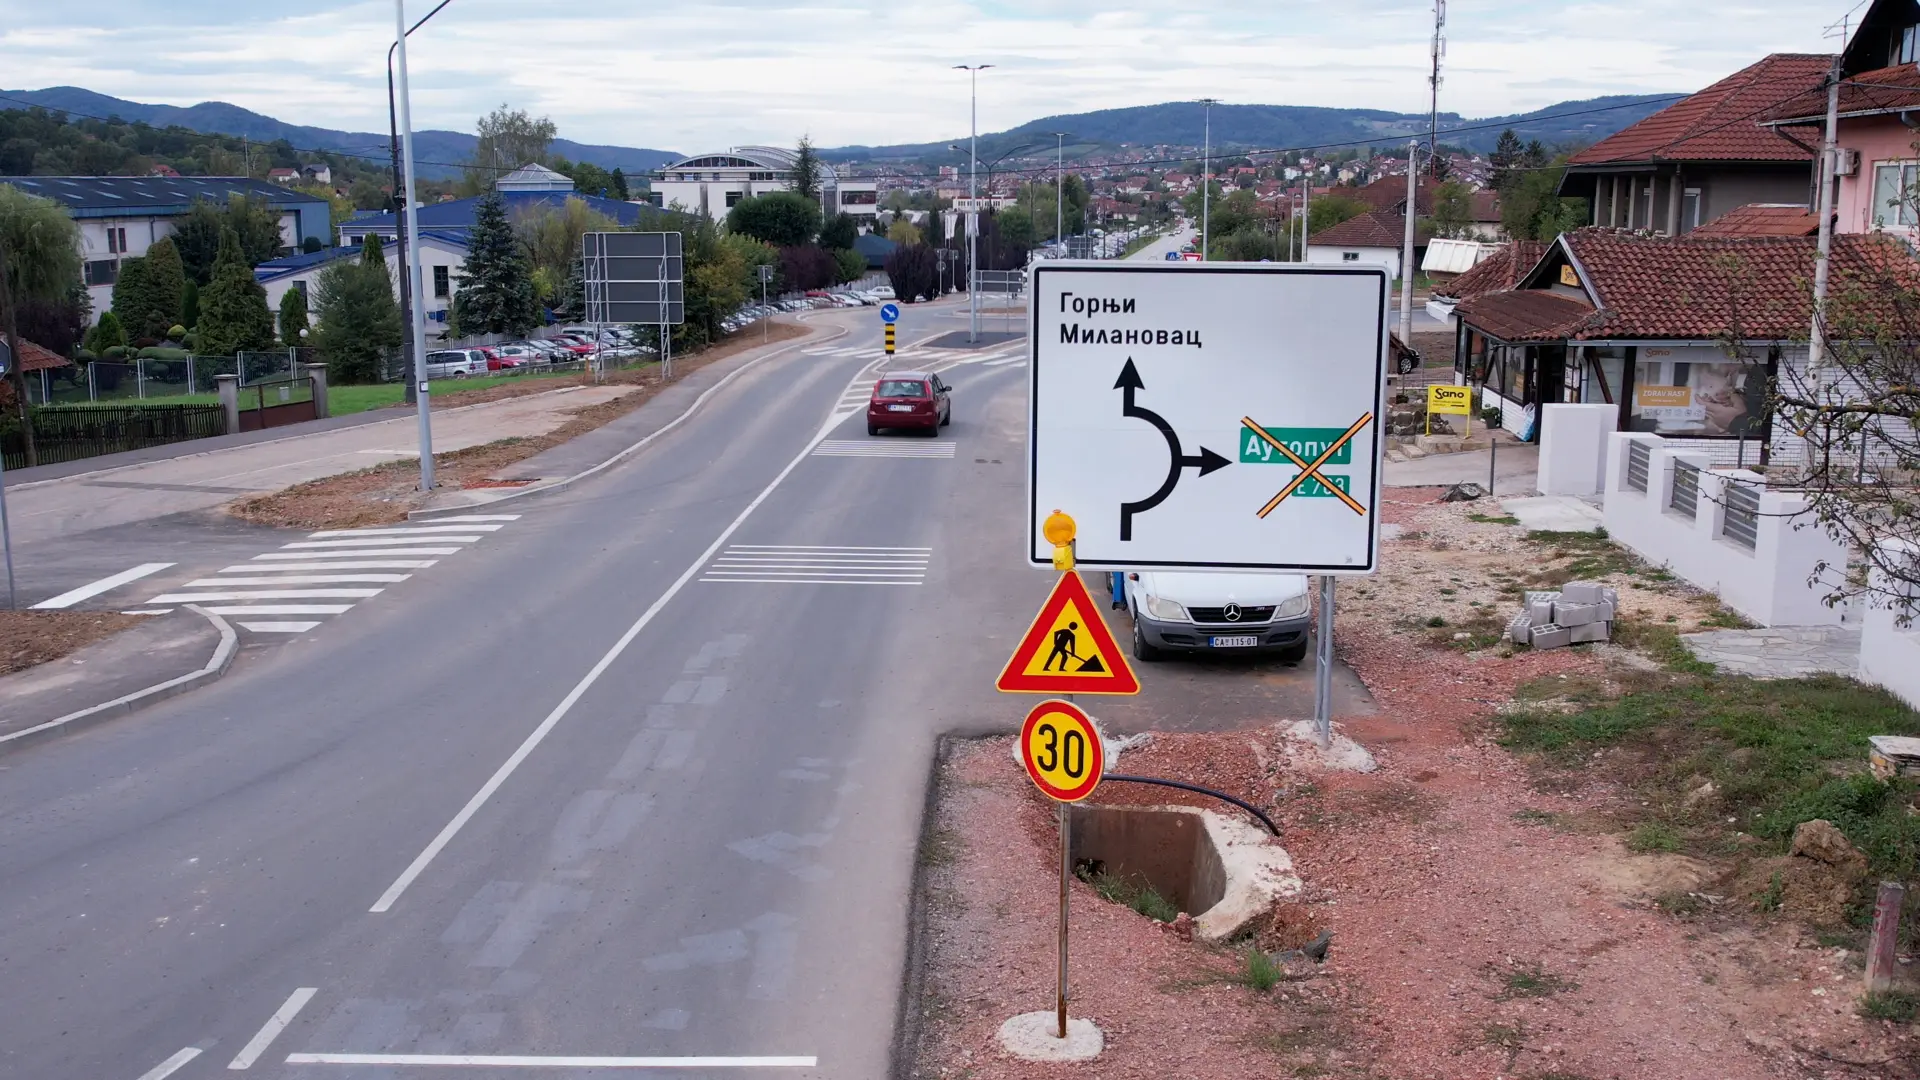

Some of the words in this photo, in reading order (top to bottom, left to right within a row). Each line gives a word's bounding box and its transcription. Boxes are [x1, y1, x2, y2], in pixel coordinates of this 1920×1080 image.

[1060, 292, 1136, 318] Горњи
[1060, 323, 1202, 348] Милановац
[1434, 387, 1465, 400] Sano
[1037, 723, 1085, 779] 30
